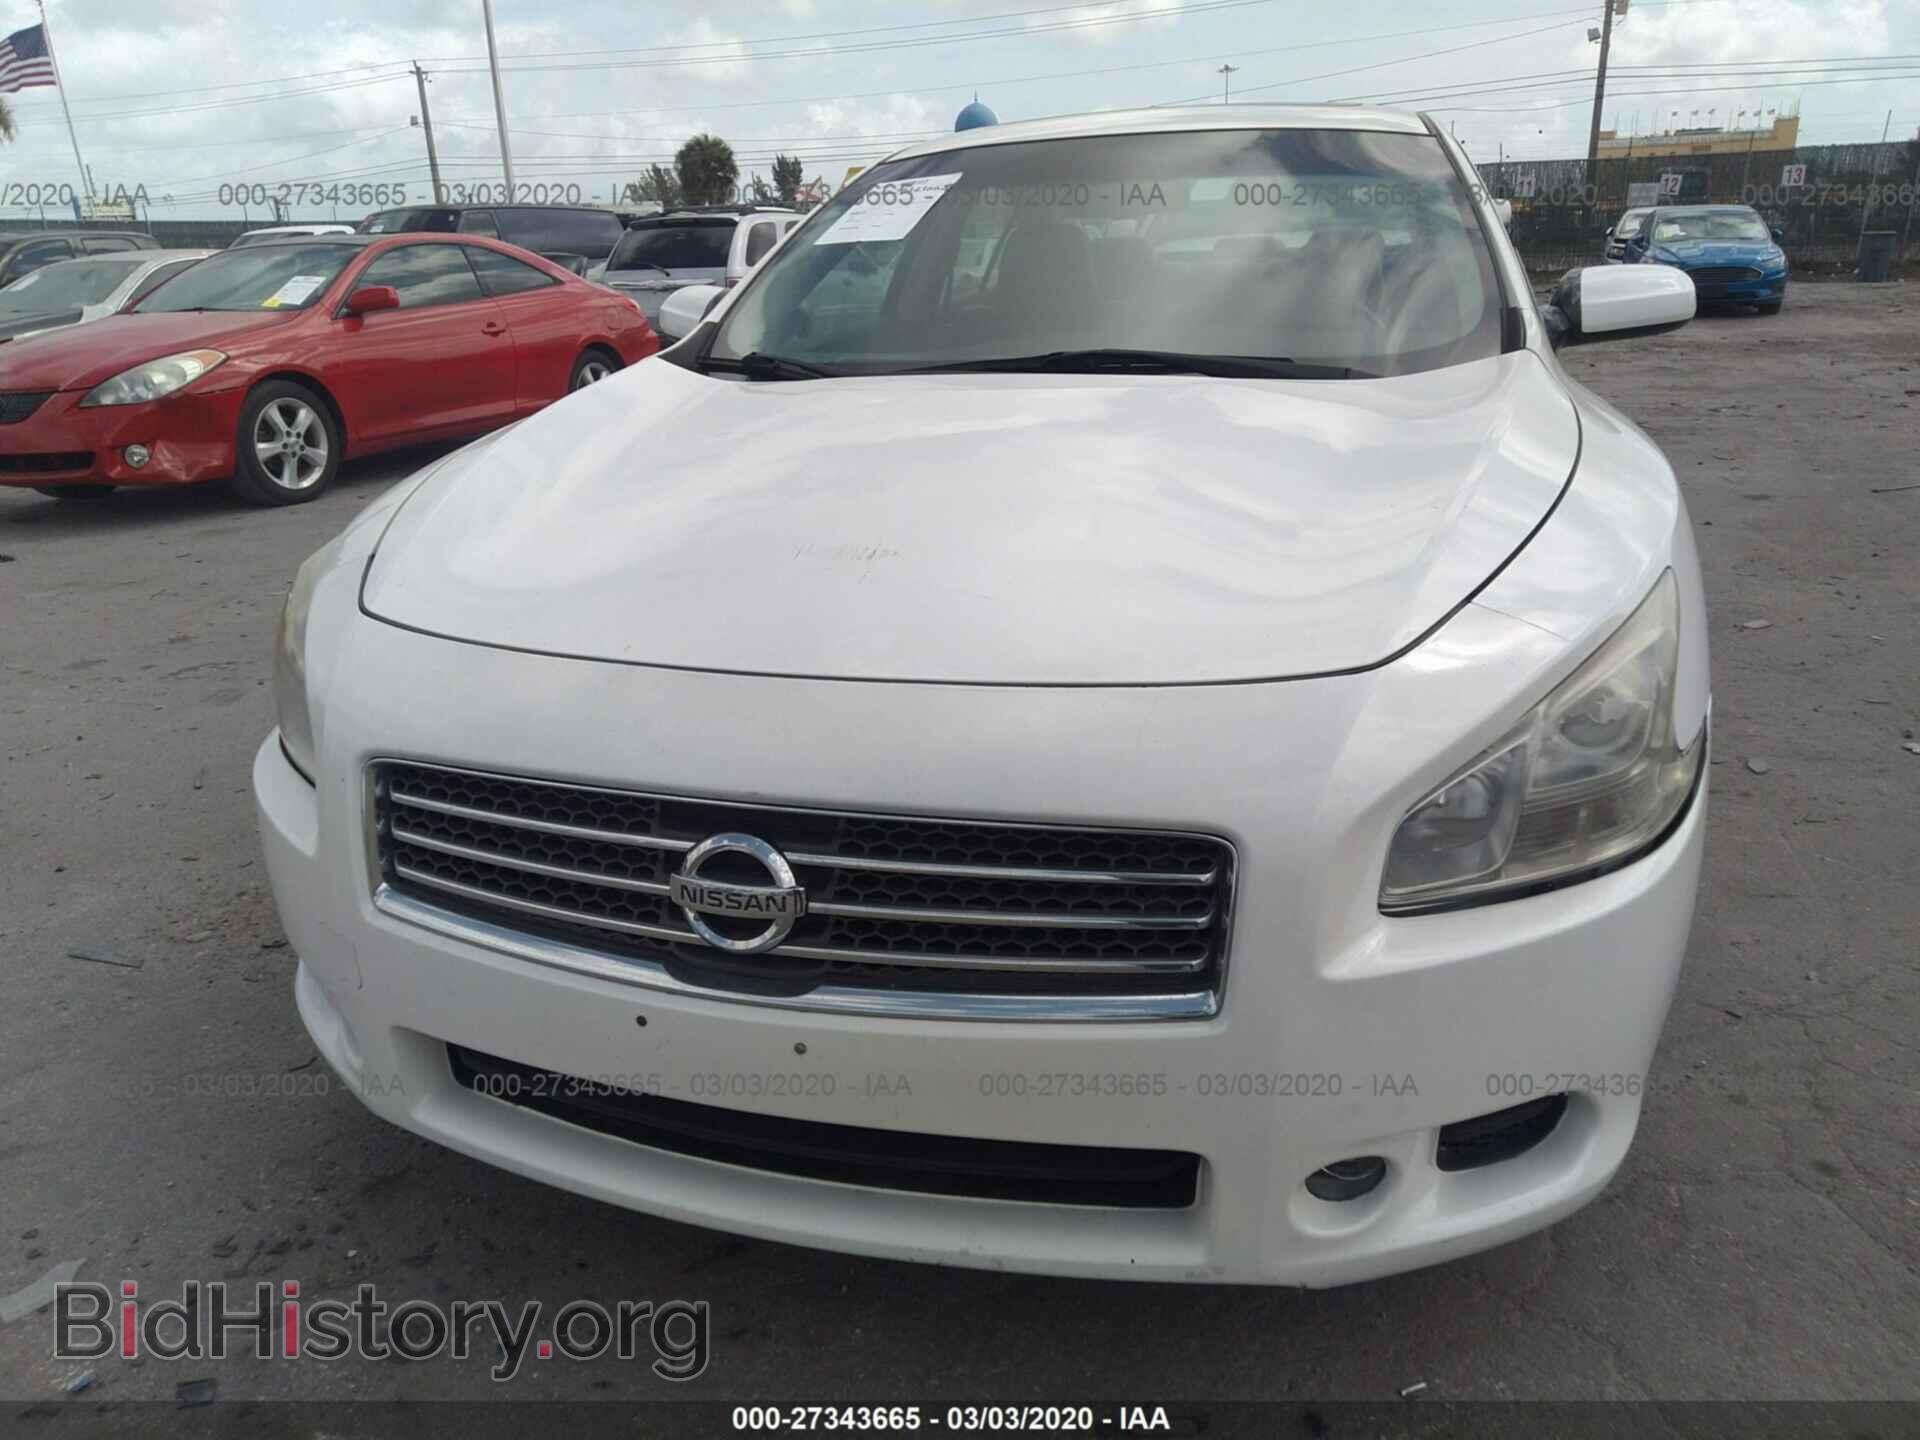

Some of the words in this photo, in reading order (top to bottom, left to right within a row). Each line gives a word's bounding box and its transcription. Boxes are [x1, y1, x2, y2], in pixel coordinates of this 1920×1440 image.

[1663, 176, 1679, 192] 12
[1786, 168, 1804, 184] 13
[1518, 178, 1534, 193] 11
[679, 884, 788, 913] NISSAN
